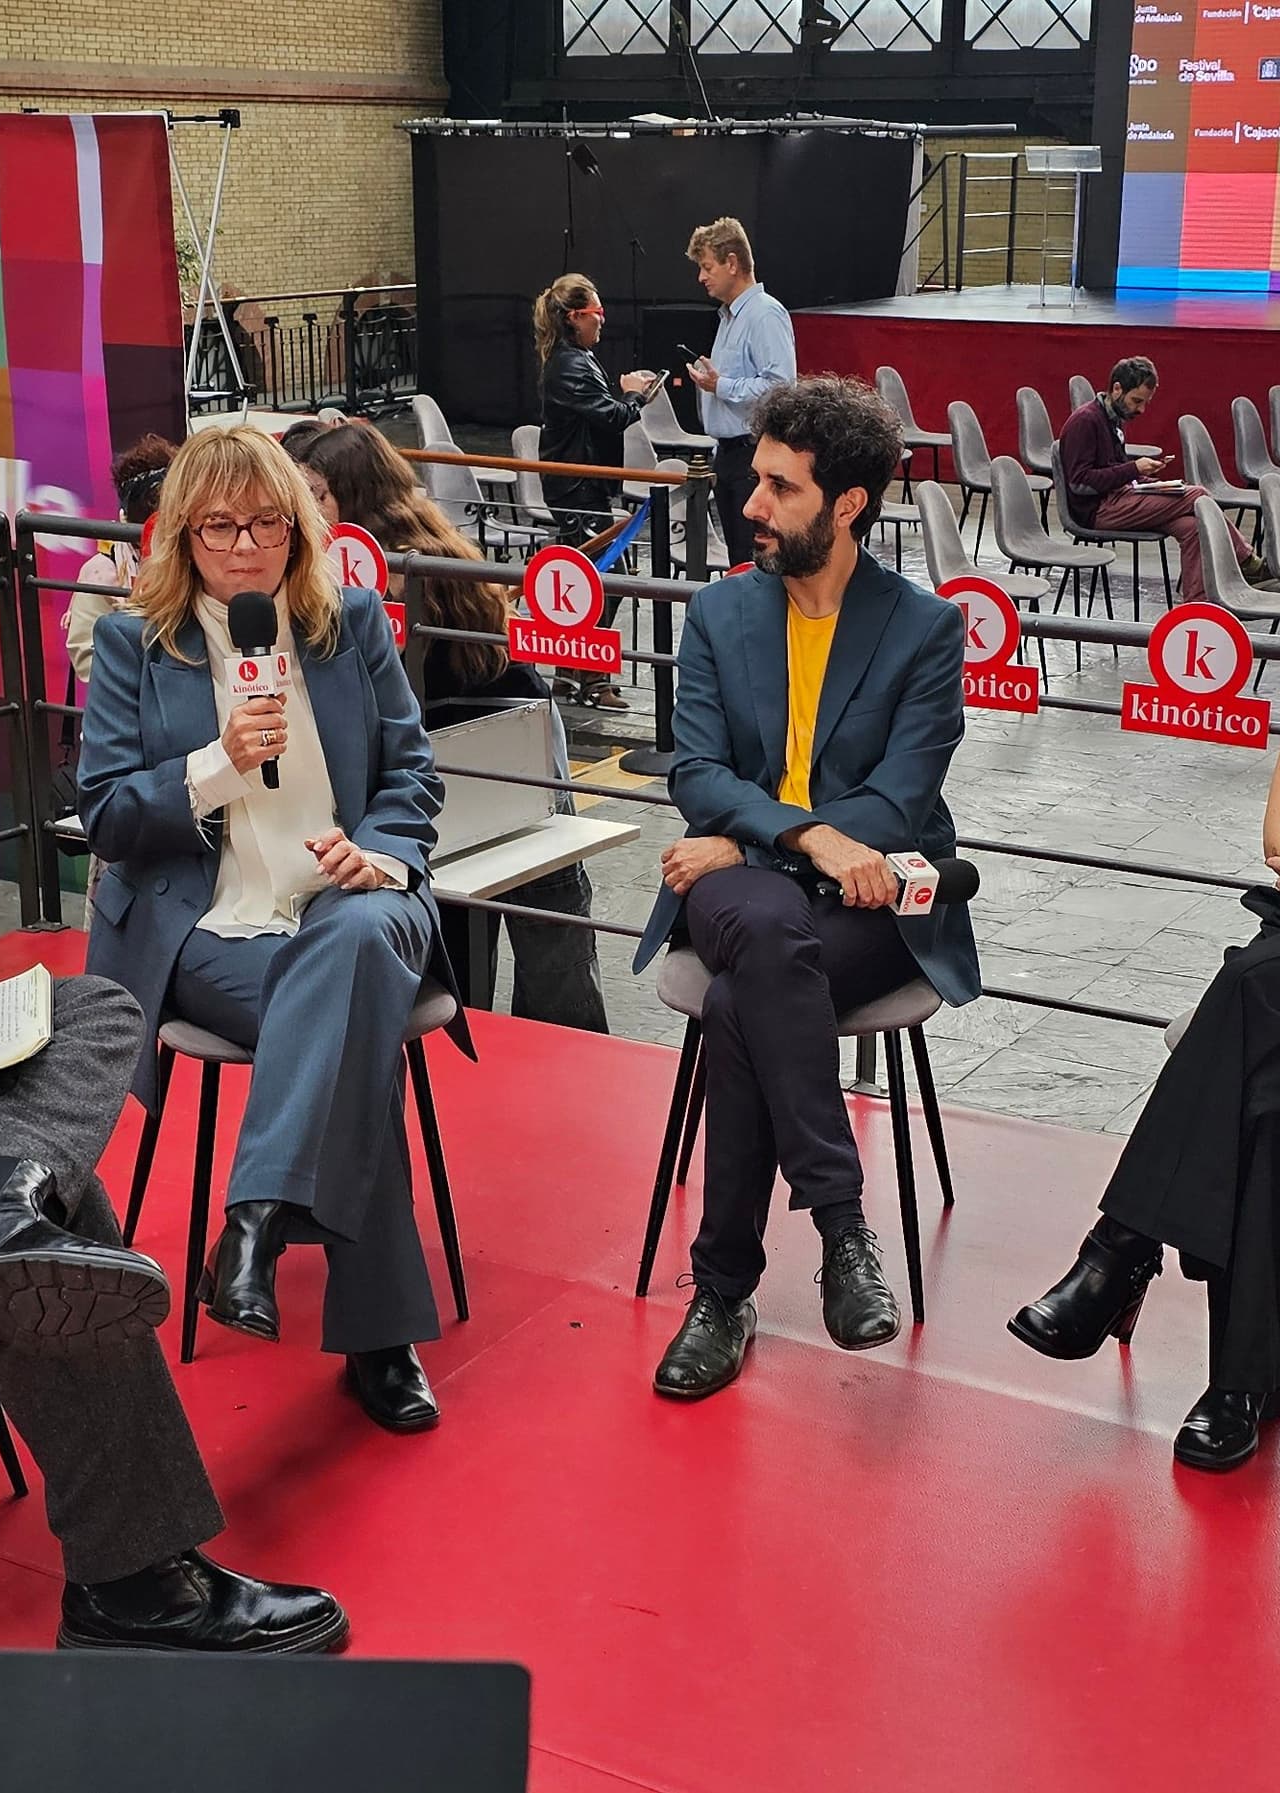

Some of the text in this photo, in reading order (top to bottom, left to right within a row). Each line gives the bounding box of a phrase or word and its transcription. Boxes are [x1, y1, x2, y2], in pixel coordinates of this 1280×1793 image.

[1135, 5, 1157, 13] Junta
[1202, 9, 1242, 18] Fundación
[1134, 13, 1182, 22] de Andalucía
[1179, 59, 1221, 71] Festival
[1179, 70, 1235, 82] de Sevilla
[1128, 122, 1150, 131] Junta
[1195, 127, 1233, 137] Fundación
[1127, 130, 1174, 140] de Andalucía
[339, 547, 364, 588] k
[550, 569, 577, 614] k
[957, 602, 989, 650] k
[515, 627, 617, 664] kinótico
[1182, 630, 1217, 681] k
[232, 684, 269, 694] kinótico
[962, 671, 1032, 702] ótico
[1130, 693, 1262, 737] kinótico
